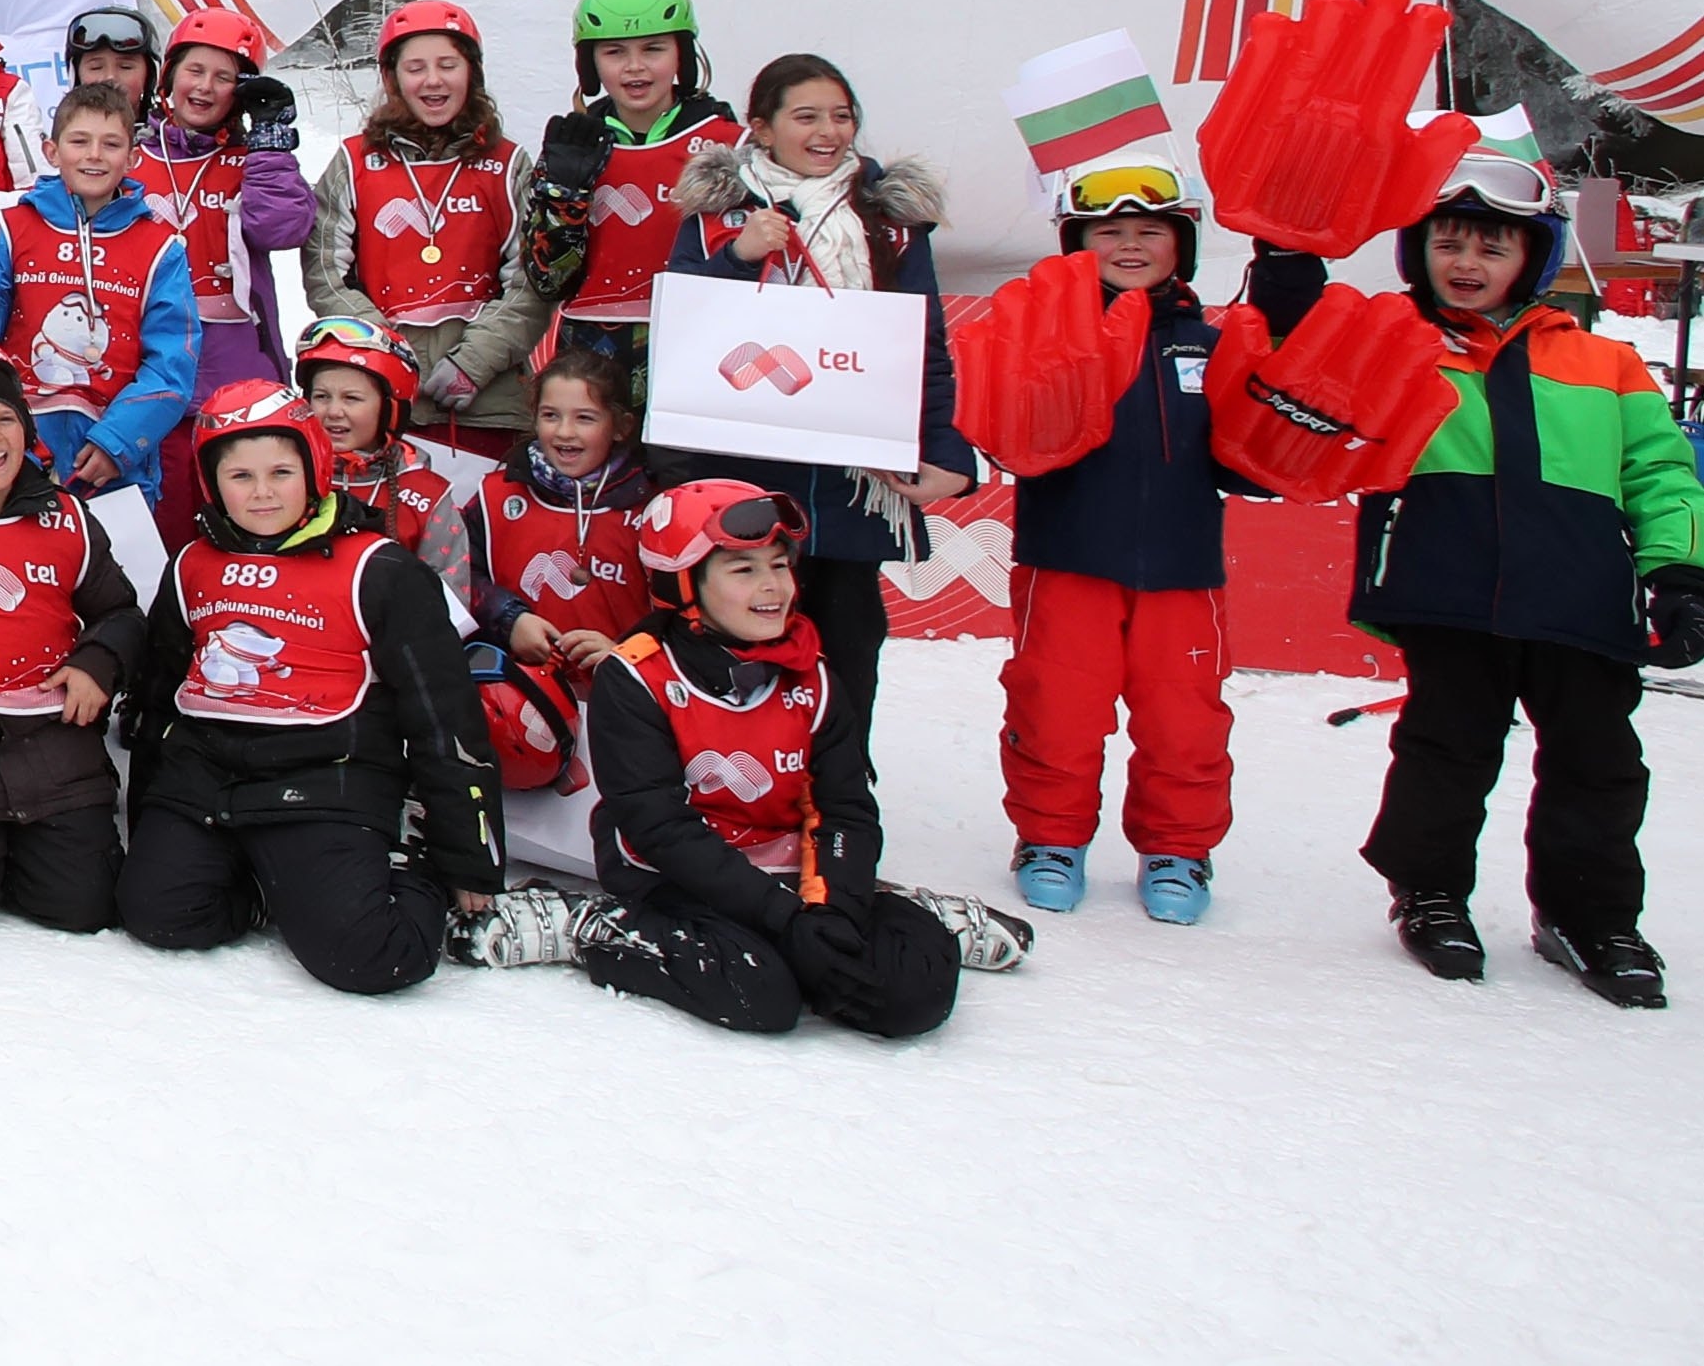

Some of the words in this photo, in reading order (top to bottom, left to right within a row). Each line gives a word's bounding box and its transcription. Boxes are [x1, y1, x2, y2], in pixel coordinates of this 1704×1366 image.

[219, 154, 246, 168] 147
[467, 158, 504, 175] 459
[446, 195, 483, 214] tel
[13, 271, 47, 287] арай
[47, 270, 140, 299] внимтелно!
[818, 347, 865, 373] tel
[397, 488, 431, 513] 456
[38, 510, 76, 533] 874
[24, 561, 59, 587] tel
[221, 563, 277, 588] 889
[589, 555, 627, 585] tel
[774, 748, 805, 774] tel
